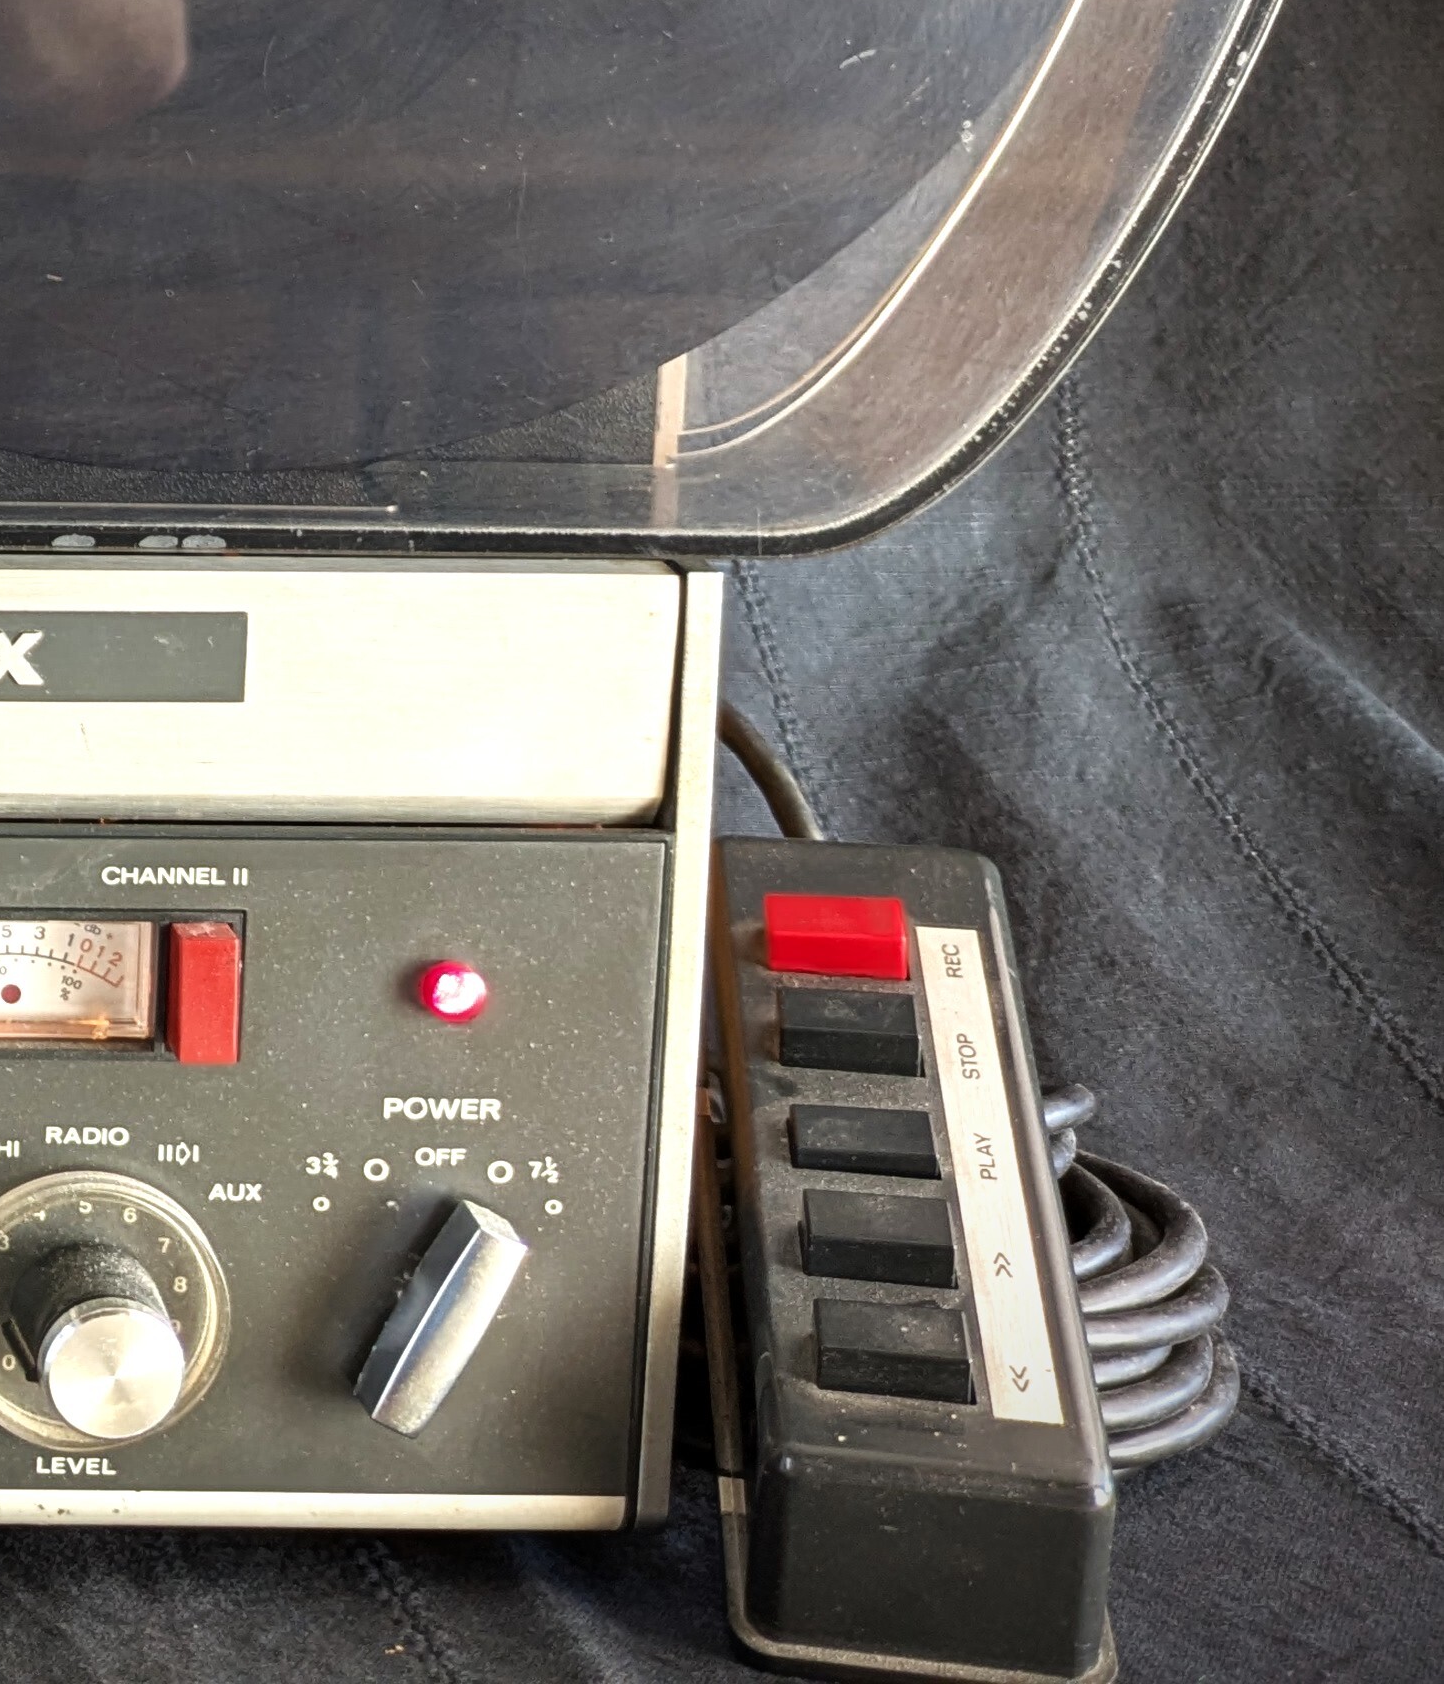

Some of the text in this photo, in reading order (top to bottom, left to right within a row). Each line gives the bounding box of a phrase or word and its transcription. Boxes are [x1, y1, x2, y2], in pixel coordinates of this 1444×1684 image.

[101, 866, 249, 887] CHANNEL II
[941, 943, 964, 979] REC
[958, 1032, 981, 1080] STOP
[383, 1096, 502, 1121] POWER
[45, 1126, 130, 1147] RADIO
[414, 1146, 468, 1167] OFF
[974, 1131, 999, 1181] PLAY
[208, 1182, 263, 1202] AUX
[123, 1207, 137, 1223] 6
[158, 1237, 171, 1253] 7
[173, 1276, 187, 1293] 8
[36, 1456, 117, 1476] LEVEL
